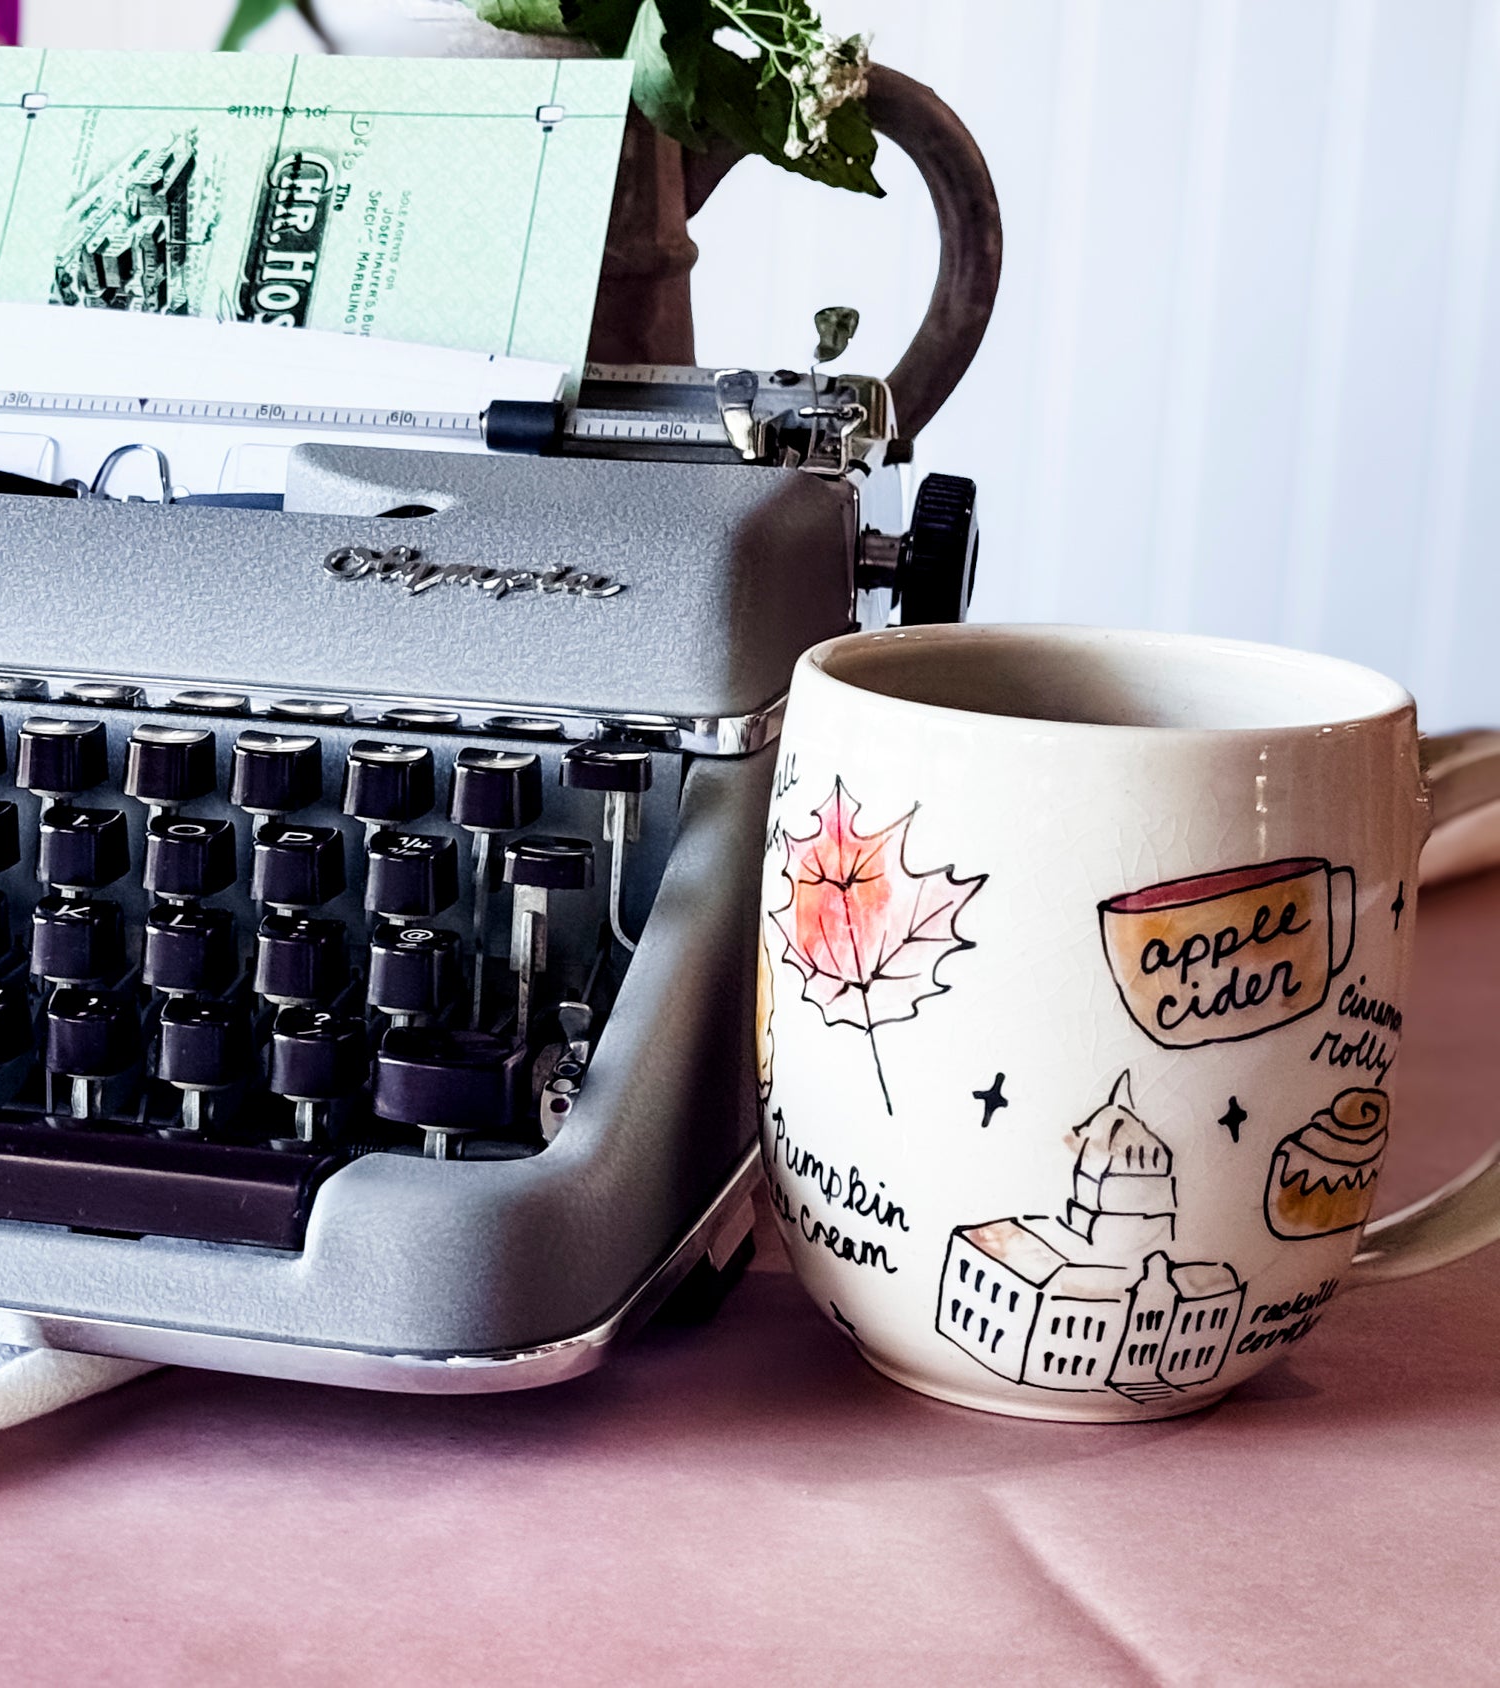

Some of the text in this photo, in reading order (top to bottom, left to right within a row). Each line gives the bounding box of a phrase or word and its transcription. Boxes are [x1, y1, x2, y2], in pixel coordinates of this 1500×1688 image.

[333, 183, 351, 212] The
[388, 220, 406, 263] AGENTS
[344, 252, 370, 325] MARBLING
[659, 423, 684, 437] 80
[322, 546, 626, 601] Olympia
[276, 831, 314, 843] P
[54, 903, 92, 919] K
[1140, 902, 1312, 984] apple
[1156, 960, 1303, 1030] cider
